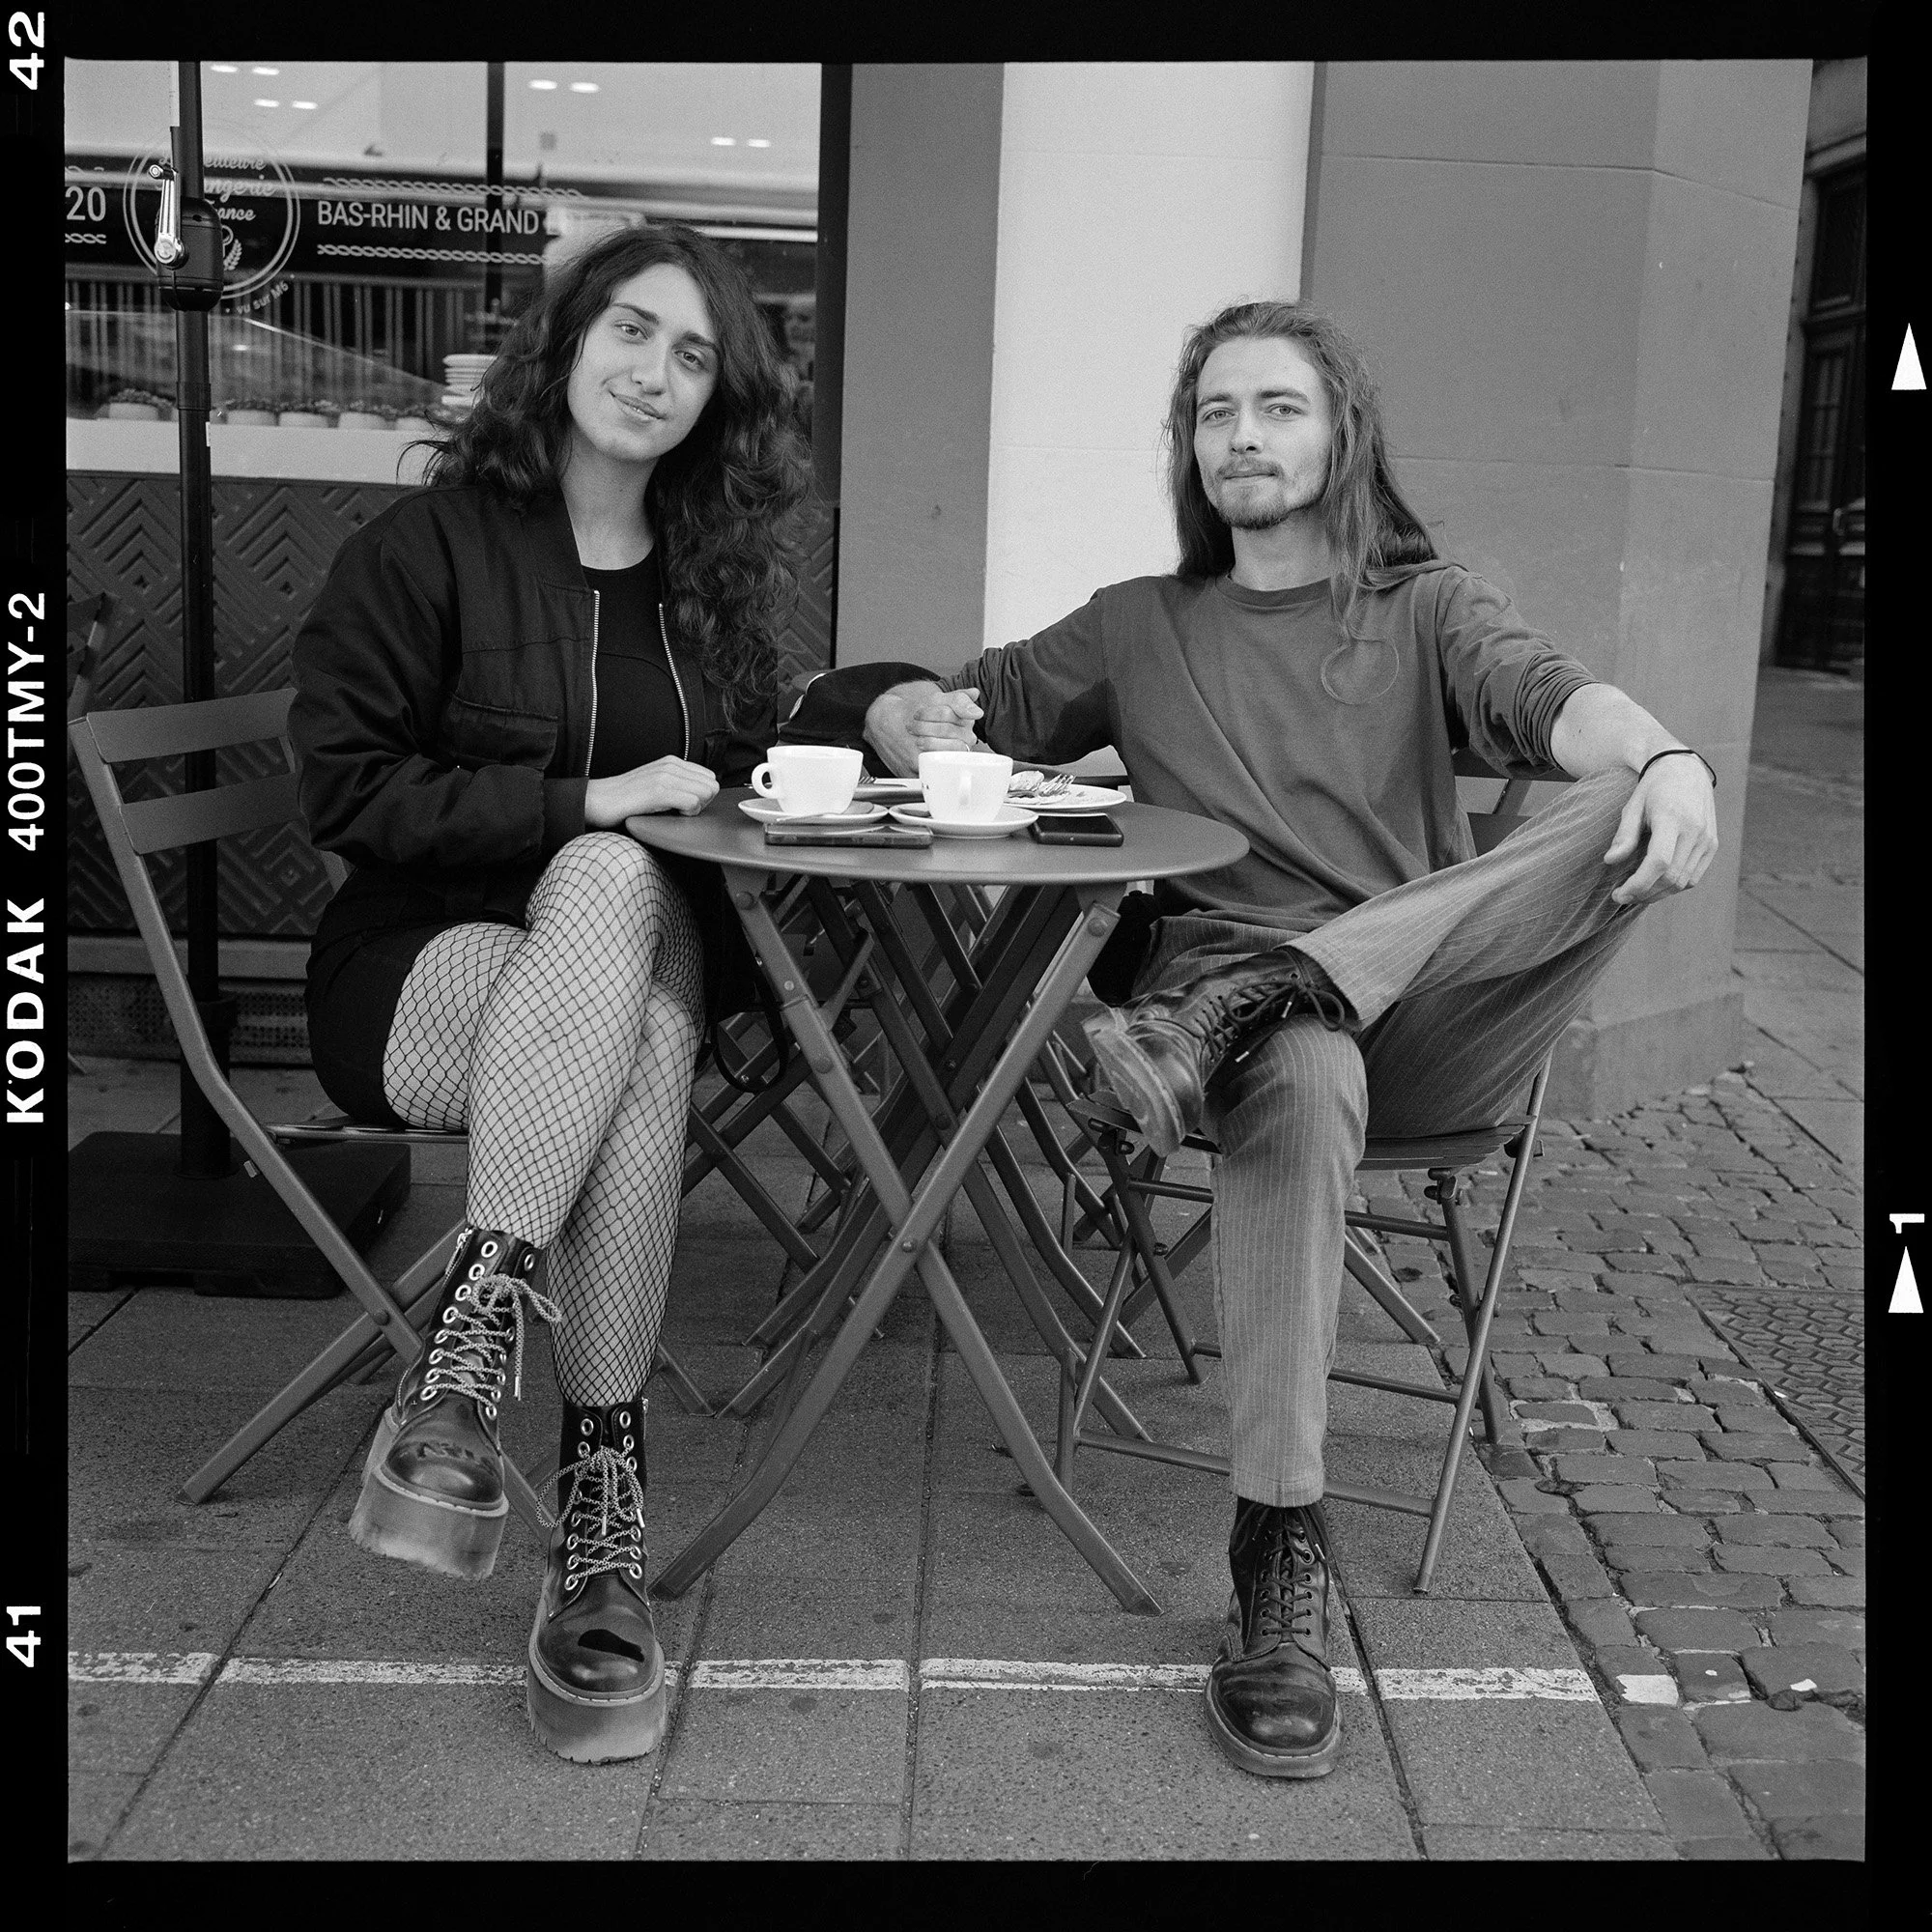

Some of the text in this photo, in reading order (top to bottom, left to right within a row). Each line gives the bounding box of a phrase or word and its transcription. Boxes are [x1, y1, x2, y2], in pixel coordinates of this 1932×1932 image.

[8, 11, 44, 91] 42
[317, 200, 540, 235] BAS-RHIN & GRAND
[6, 592, 45, 1123] KODAK 400TMY-2
[7, 1605, 42, 1668] 41
